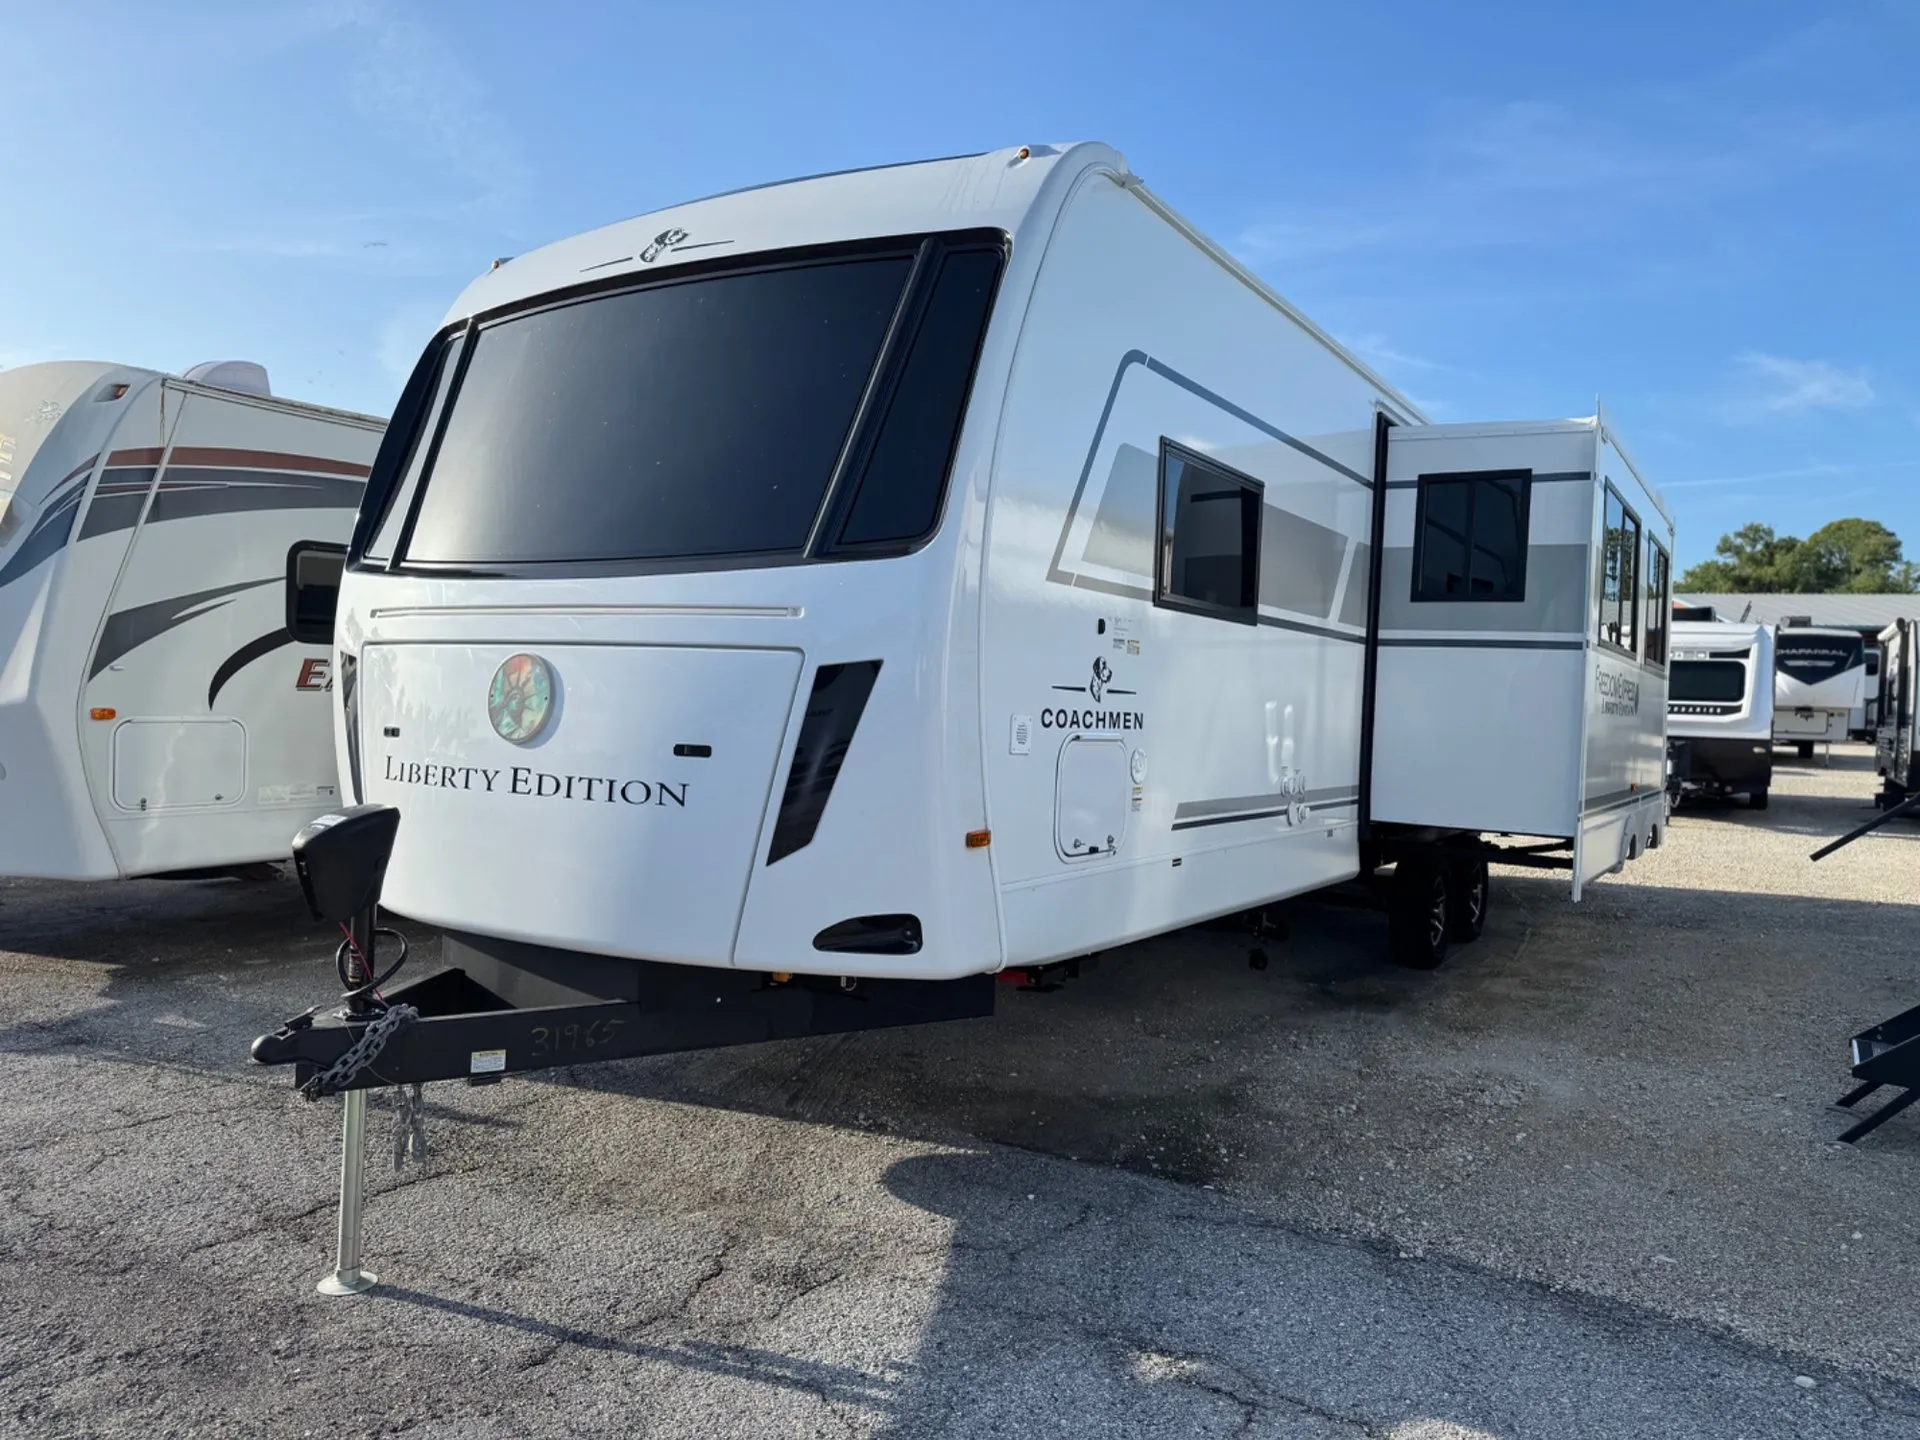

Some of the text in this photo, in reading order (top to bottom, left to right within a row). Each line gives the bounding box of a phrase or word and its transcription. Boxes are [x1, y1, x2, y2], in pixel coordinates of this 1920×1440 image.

[1041, 708, 1144, 730] COACHMEN
[385, 756, 690, 807] LIBERTY EDITION
[531, 1019, 627, 1057] 31965
